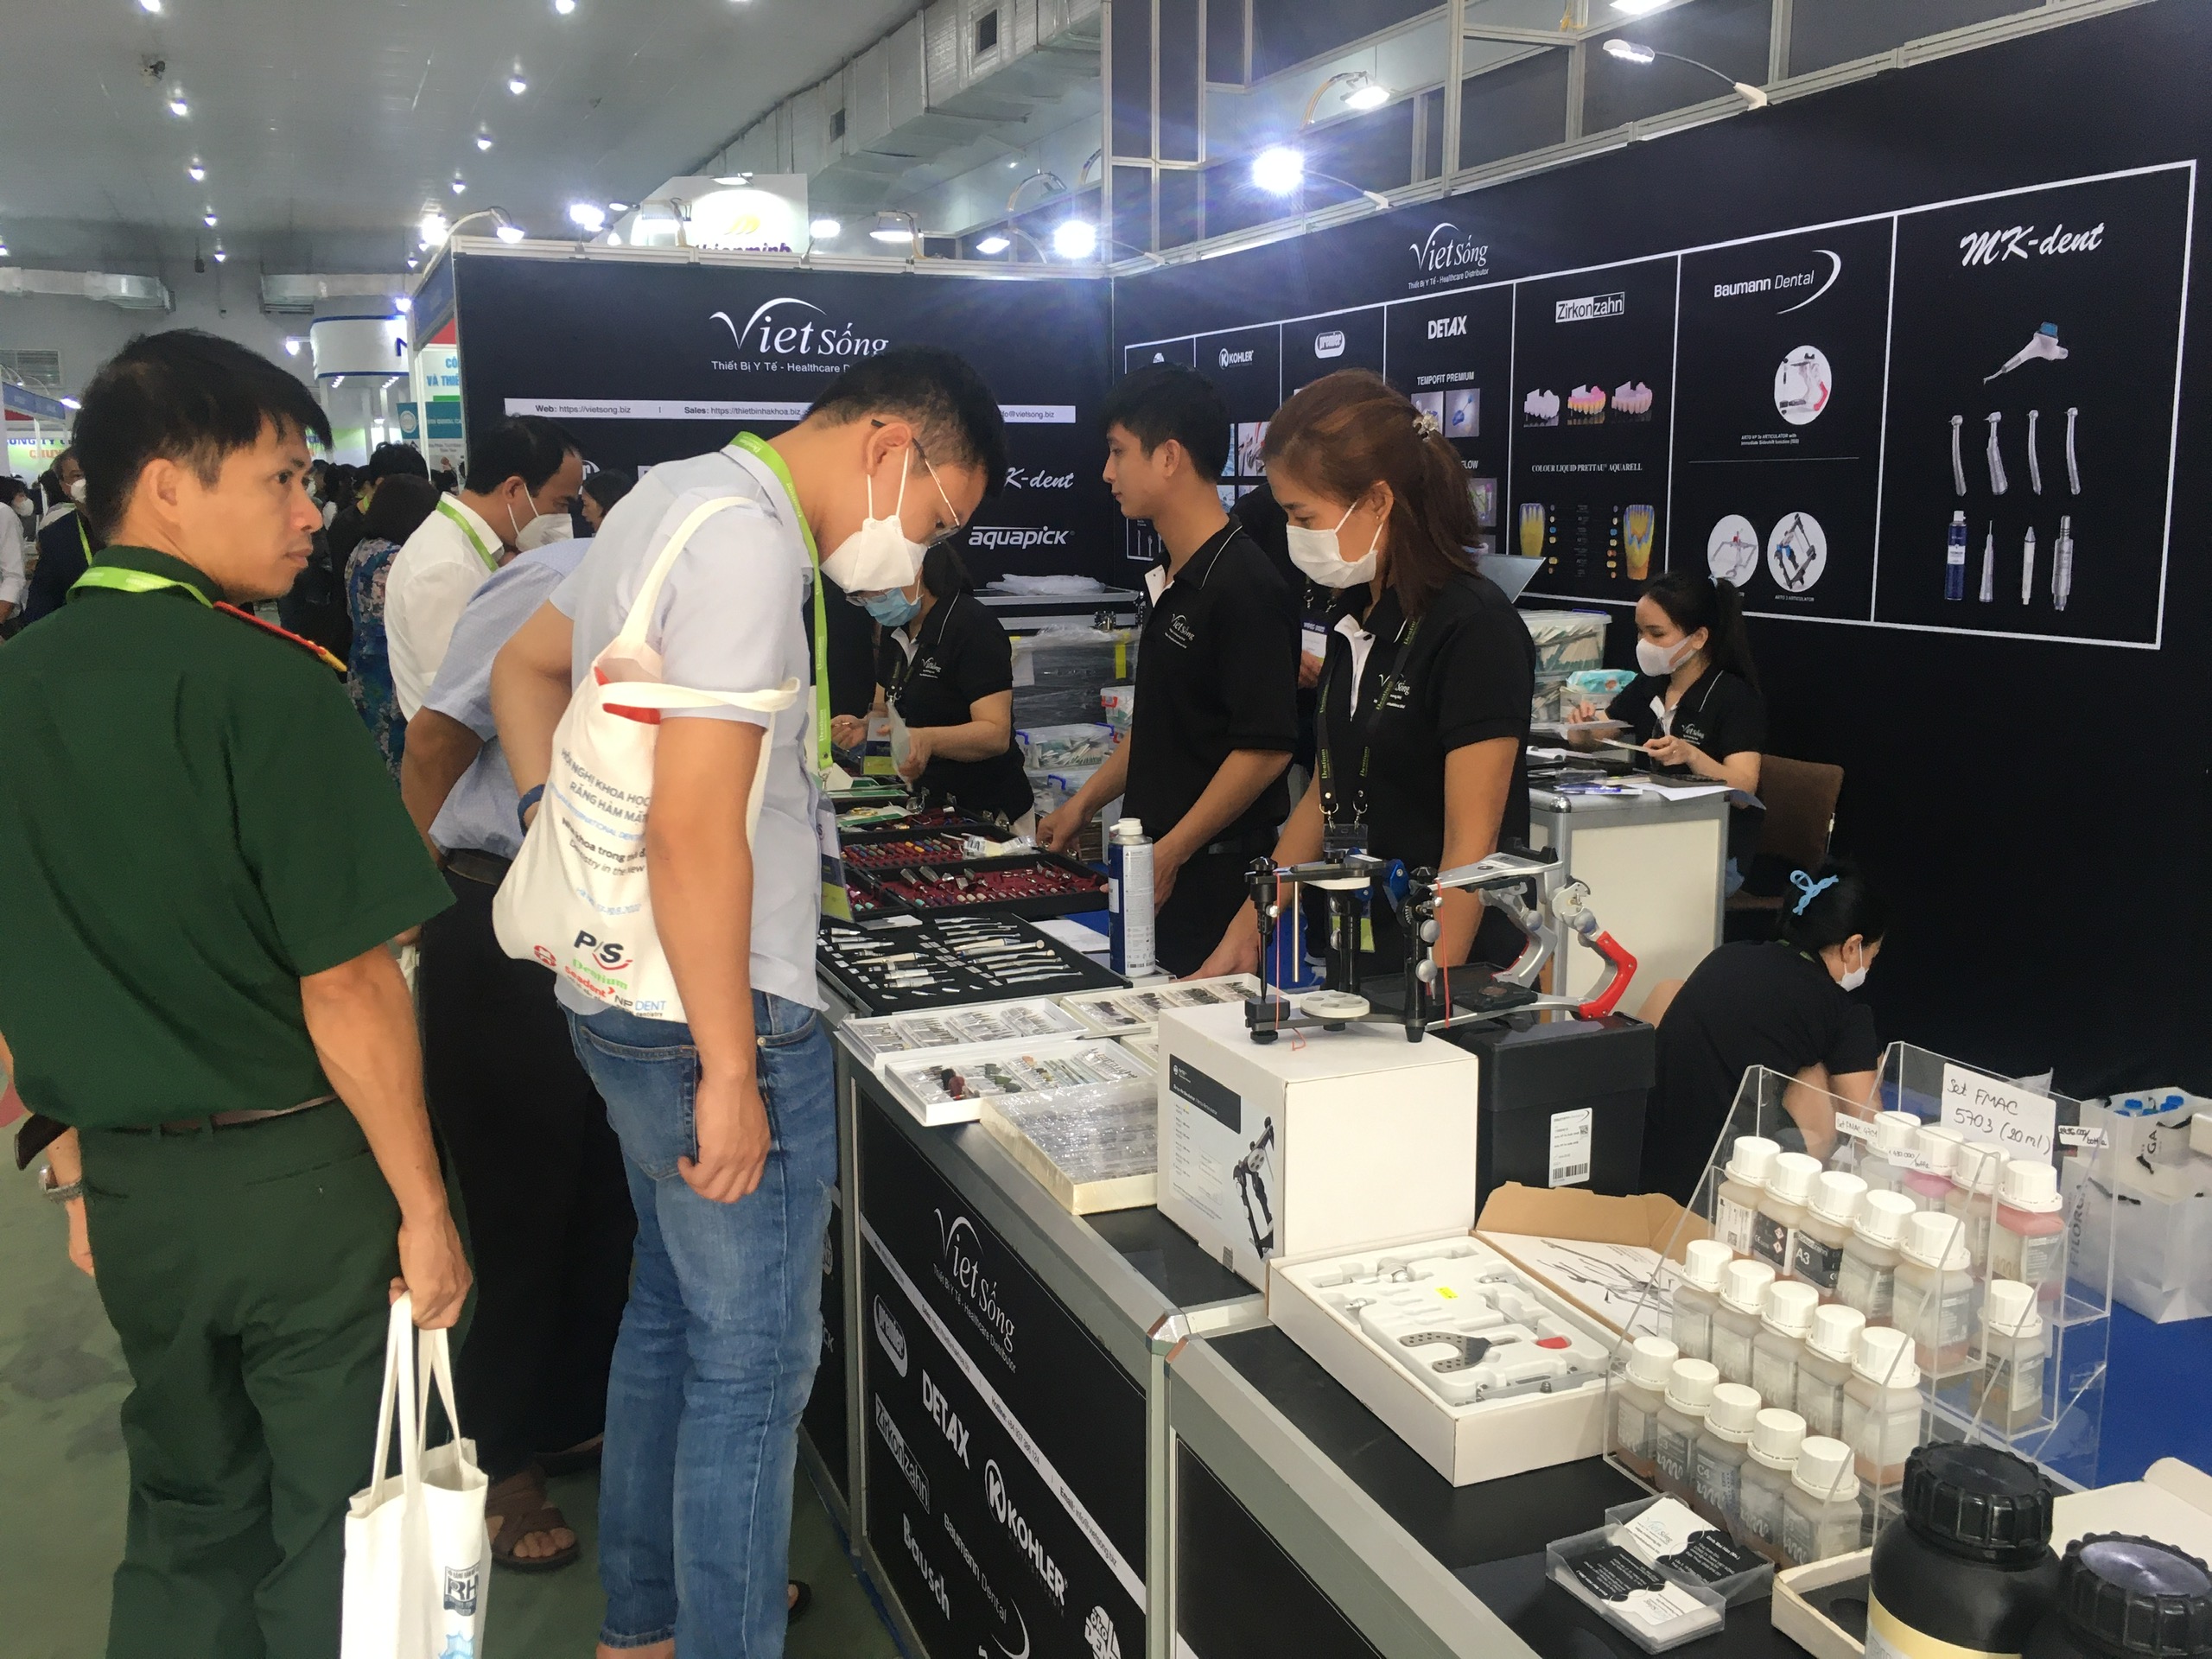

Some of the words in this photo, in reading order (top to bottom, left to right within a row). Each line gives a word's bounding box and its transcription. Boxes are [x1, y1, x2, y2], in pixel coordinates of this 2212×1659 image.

[1409, 222, 1459, 270] Viet
[1453, 234, 1488, 267] Sống
[1960, 222, 2105, 266] MK-dent
[1440, 273, 1464, 283] Healthcare
[1465, 269, 1489, 279] Distributor
[1713, 278, 1771, 297] Baumann
[1774, 270, 1815, 289] Dental
[1557, 296, 1624, 321] Zirkonzahn
[709, 297, 827, 353] Viet
[817, 322, 889, 359] Sống
[1427, 315, 1467, 340] DETAX
[711, 360, 737, 372] Thiết
[741, 361, 751, 372] Bị
[764, 360, 778, 372] Tế
[787, 363, 841, 372] Healthcare
[1229, 351, 1252, 365] KOHLER
[1417, 374, 1446, 386] TEMPOFIT
[1446, 372, 1474, 383] PREMIUM
[535, 404, 557, 413] Web:
[559, 404, 631, 415] https://vietsong.biz
[684, 406, 709, 415] Sales:
[710, 406, 801, 416] https://thietbinhakhoa.biz
[1001, 410, 1054, 419] fo@vietsong.biz
[1004, 467, 1074, 489] K-dent
[1556, 464, 1577, 474] LIQUID
[1608, 463, 1643, 473] AQUARELL
[969, 525, 1070, 550] aquapick
[569, 781, 598, 806] RĂNG
[597, 800, 624, 818] HÀM
[595, 778, 626, 801] KHOA
[626, 792, 651, 809] HỌC
[598, 846, 626, 863] trong
[573, 929, 624, 963] P/S
[572, 958, 628, 990] Dentium
[614, 995, 633, 1007] NP
[635, 1000, 667, 1012] DENT
[1947, 1078, 1967, 1096] Set
[1975, 1090, 2018, 1116] FMAC
[1954, 1107, 1993, 1134] 5703
[1796, 1247, 1810, 1265] A3
[934, 1208, 984, 1298] Viet
[979, 1278, 1014, 1353] Sống
[922, 1368, 969, 1470] DETAX
[877, 1401, 928, 1508] Zirkonzahn
[1007, 1498, 1065, 1606] KOHLER
[903, 1513, 950, 1621] Bausch
[944, 1512, 980, 1582] Baumann
[981, 1573, 1007, 1624] Dental
[1090, 1608, 1108, 1641] öko
